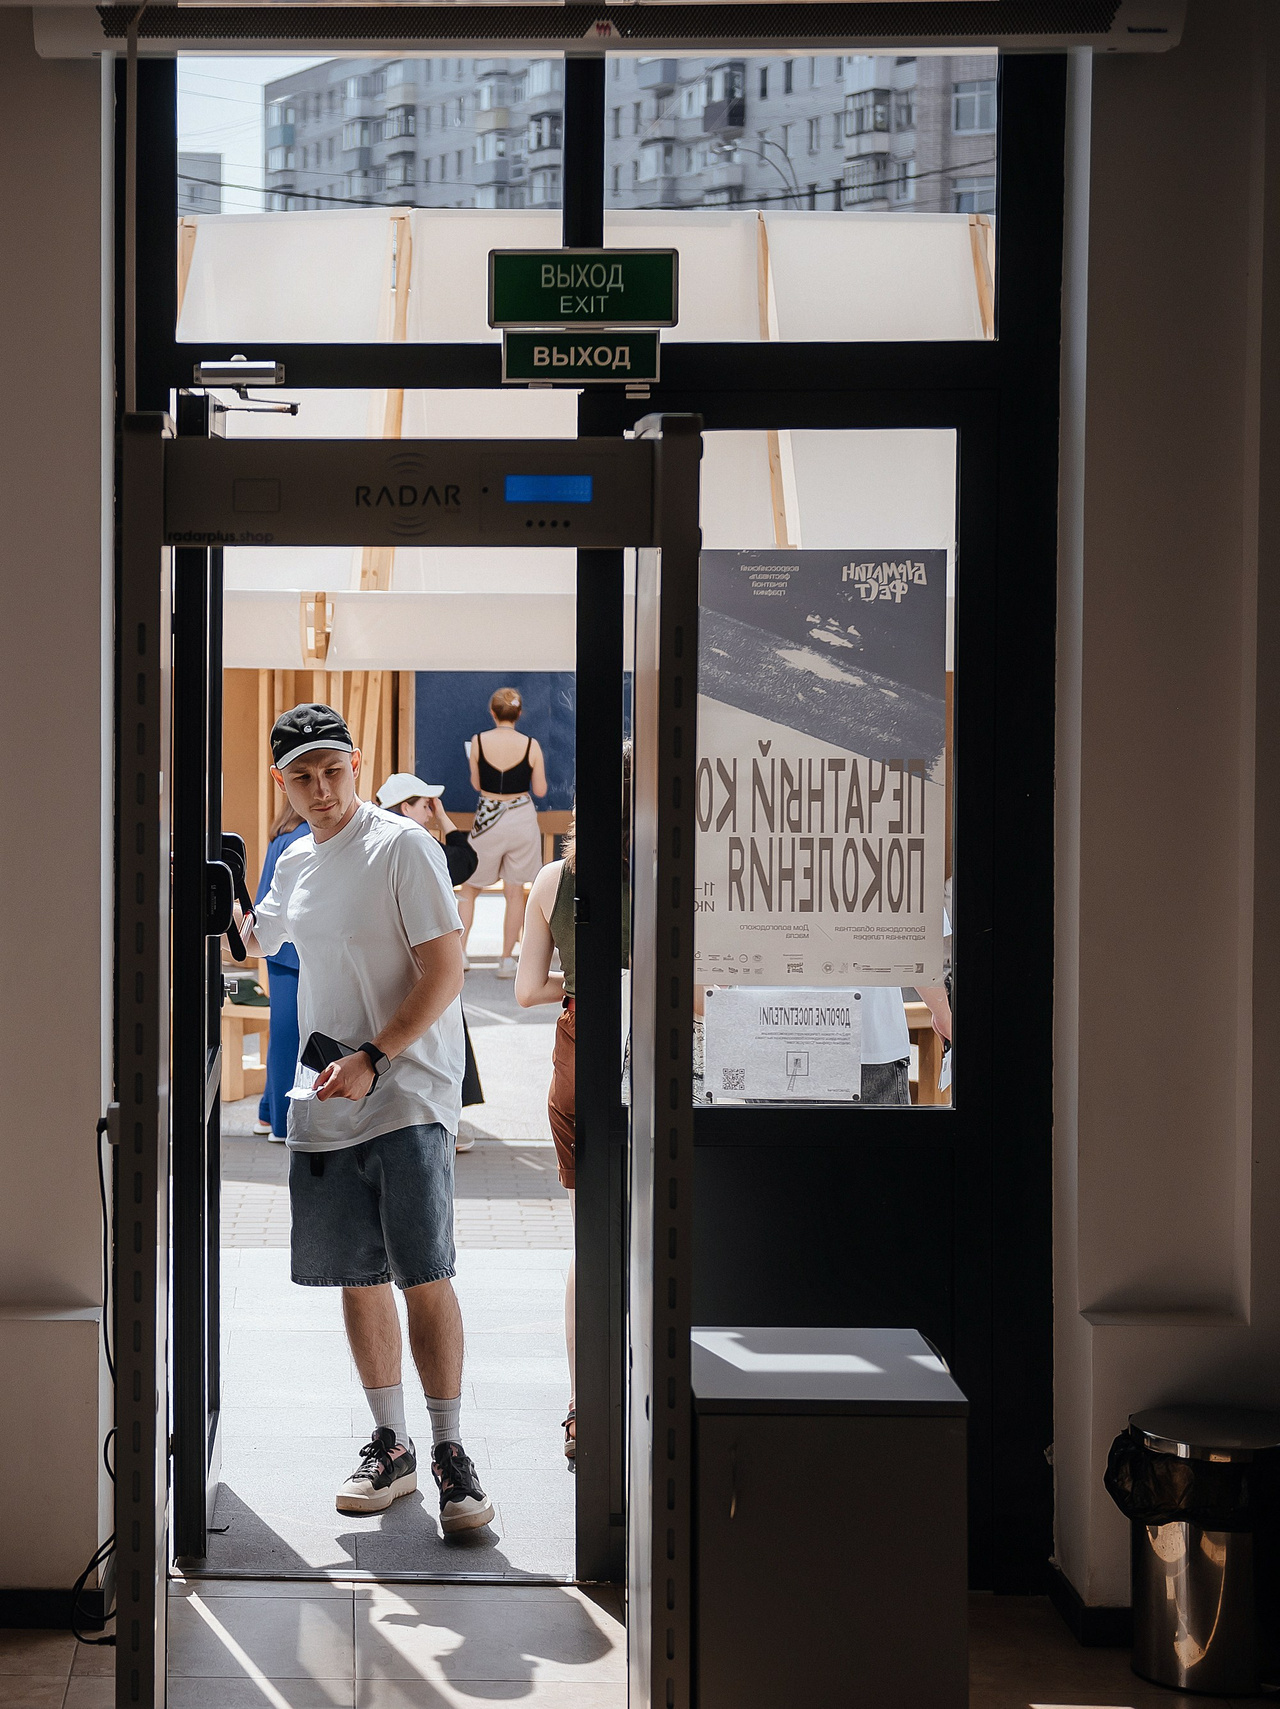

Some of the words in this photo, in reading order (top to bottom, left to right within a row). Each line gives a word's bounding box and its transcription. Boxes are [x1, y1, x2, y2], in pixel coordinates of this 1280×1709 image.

[541, 264, 624, 292] ВЫХОД
[560, 296, 609, 313] EXIT
[534, 347, 631, 370] ВЫХОД
[355, 485, 461, 507] RADAR
